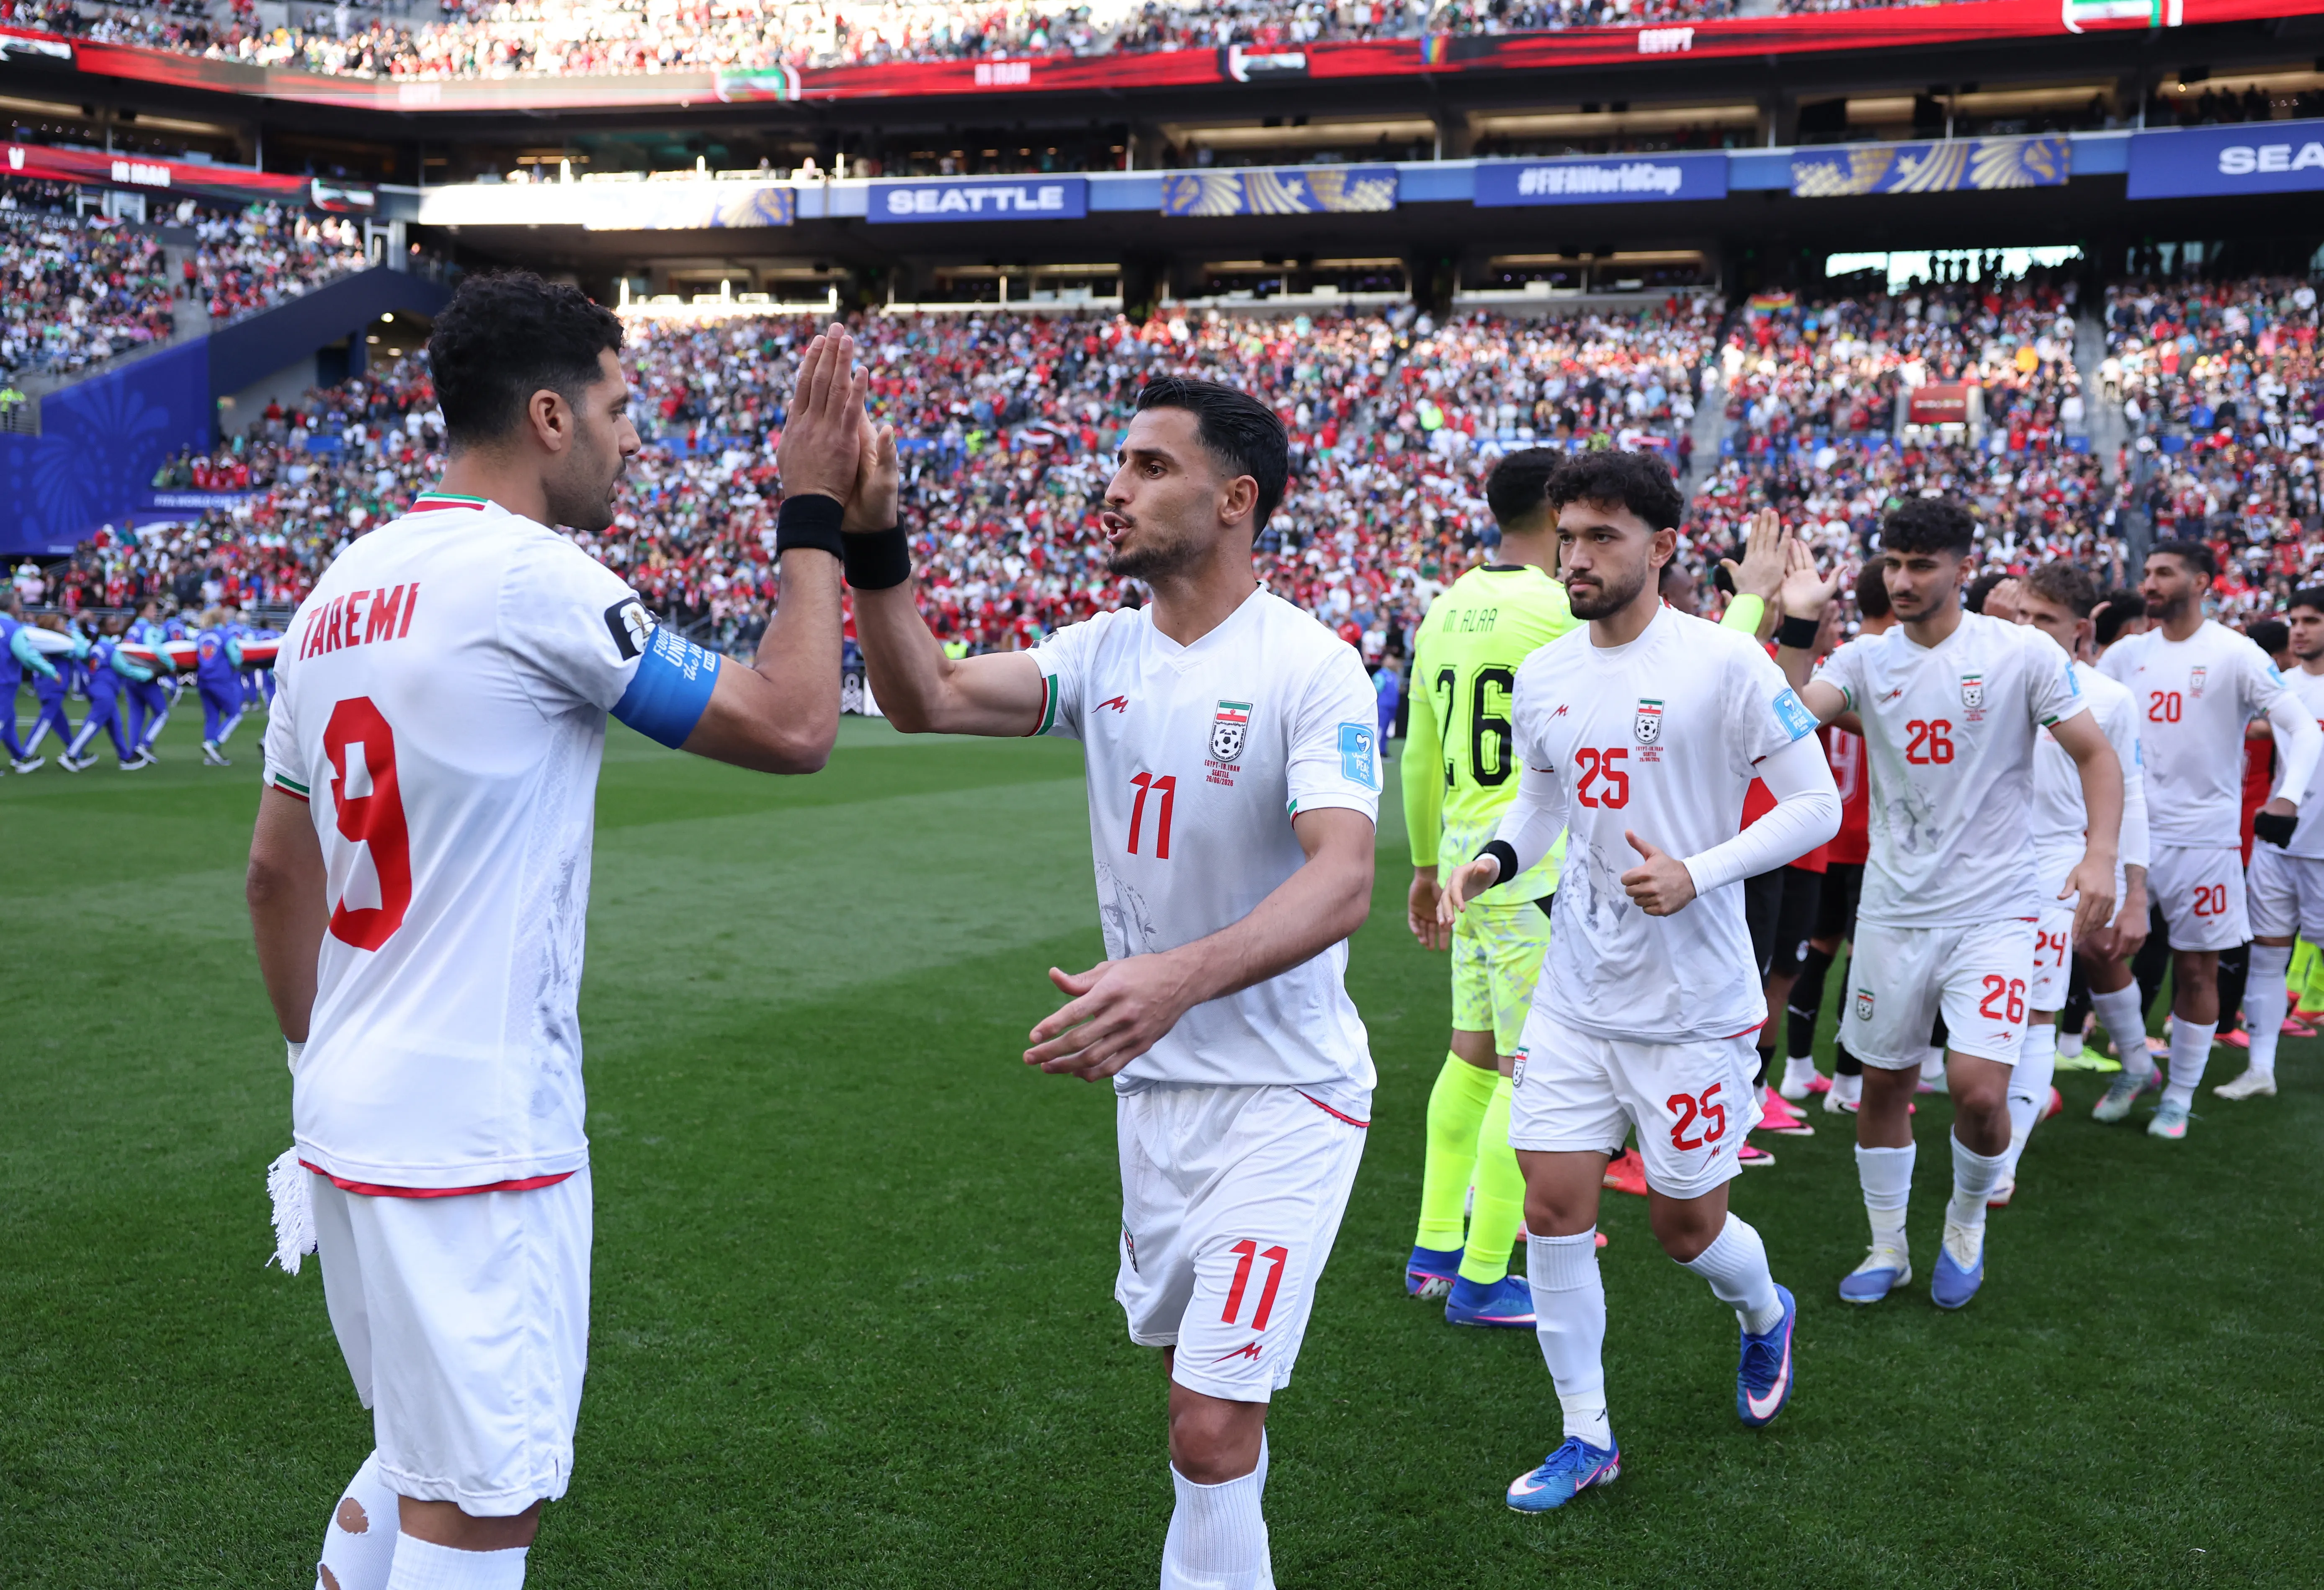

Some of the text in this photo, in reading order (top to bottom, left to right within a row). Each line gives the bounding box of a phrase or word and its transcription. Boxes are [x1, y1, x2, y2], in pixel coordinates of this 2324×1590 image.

[2217, 142, 2324, 175] SEA
[1518, 162, 1682, 196] #FIFAWorldCup
[887, 186, 1064, 214] SEATTLE
[299, 582, 420, 661] TAREMI
[1460, 608, 1497, 632] ALAA
[683, 658, 699, 681] the
[2149, 691, 2182, 723] 20
[1435, 663, 1517, 792] 26
[1906, 719, 1954, 765] 26
[1204, 759, 1240, 772] EGYPT-IR.IRAN
[1206, 775, 1234, 786] 26/06/2026
[1212, 769, 1229, 778] SEATTLE
[1575, 748, 1628, 809] 25
[323, 696, 412, 952] 9
[1127, 772, 1176, 859] 11
[2194, 884, 2226, 917] 20
[2034, 930, 2066, 967] 24
[1979, 974, 2026, 1024] 26
[1667, 1082, 1726, 1151] 25
[1221, 1240, 1288, 1332] 11
